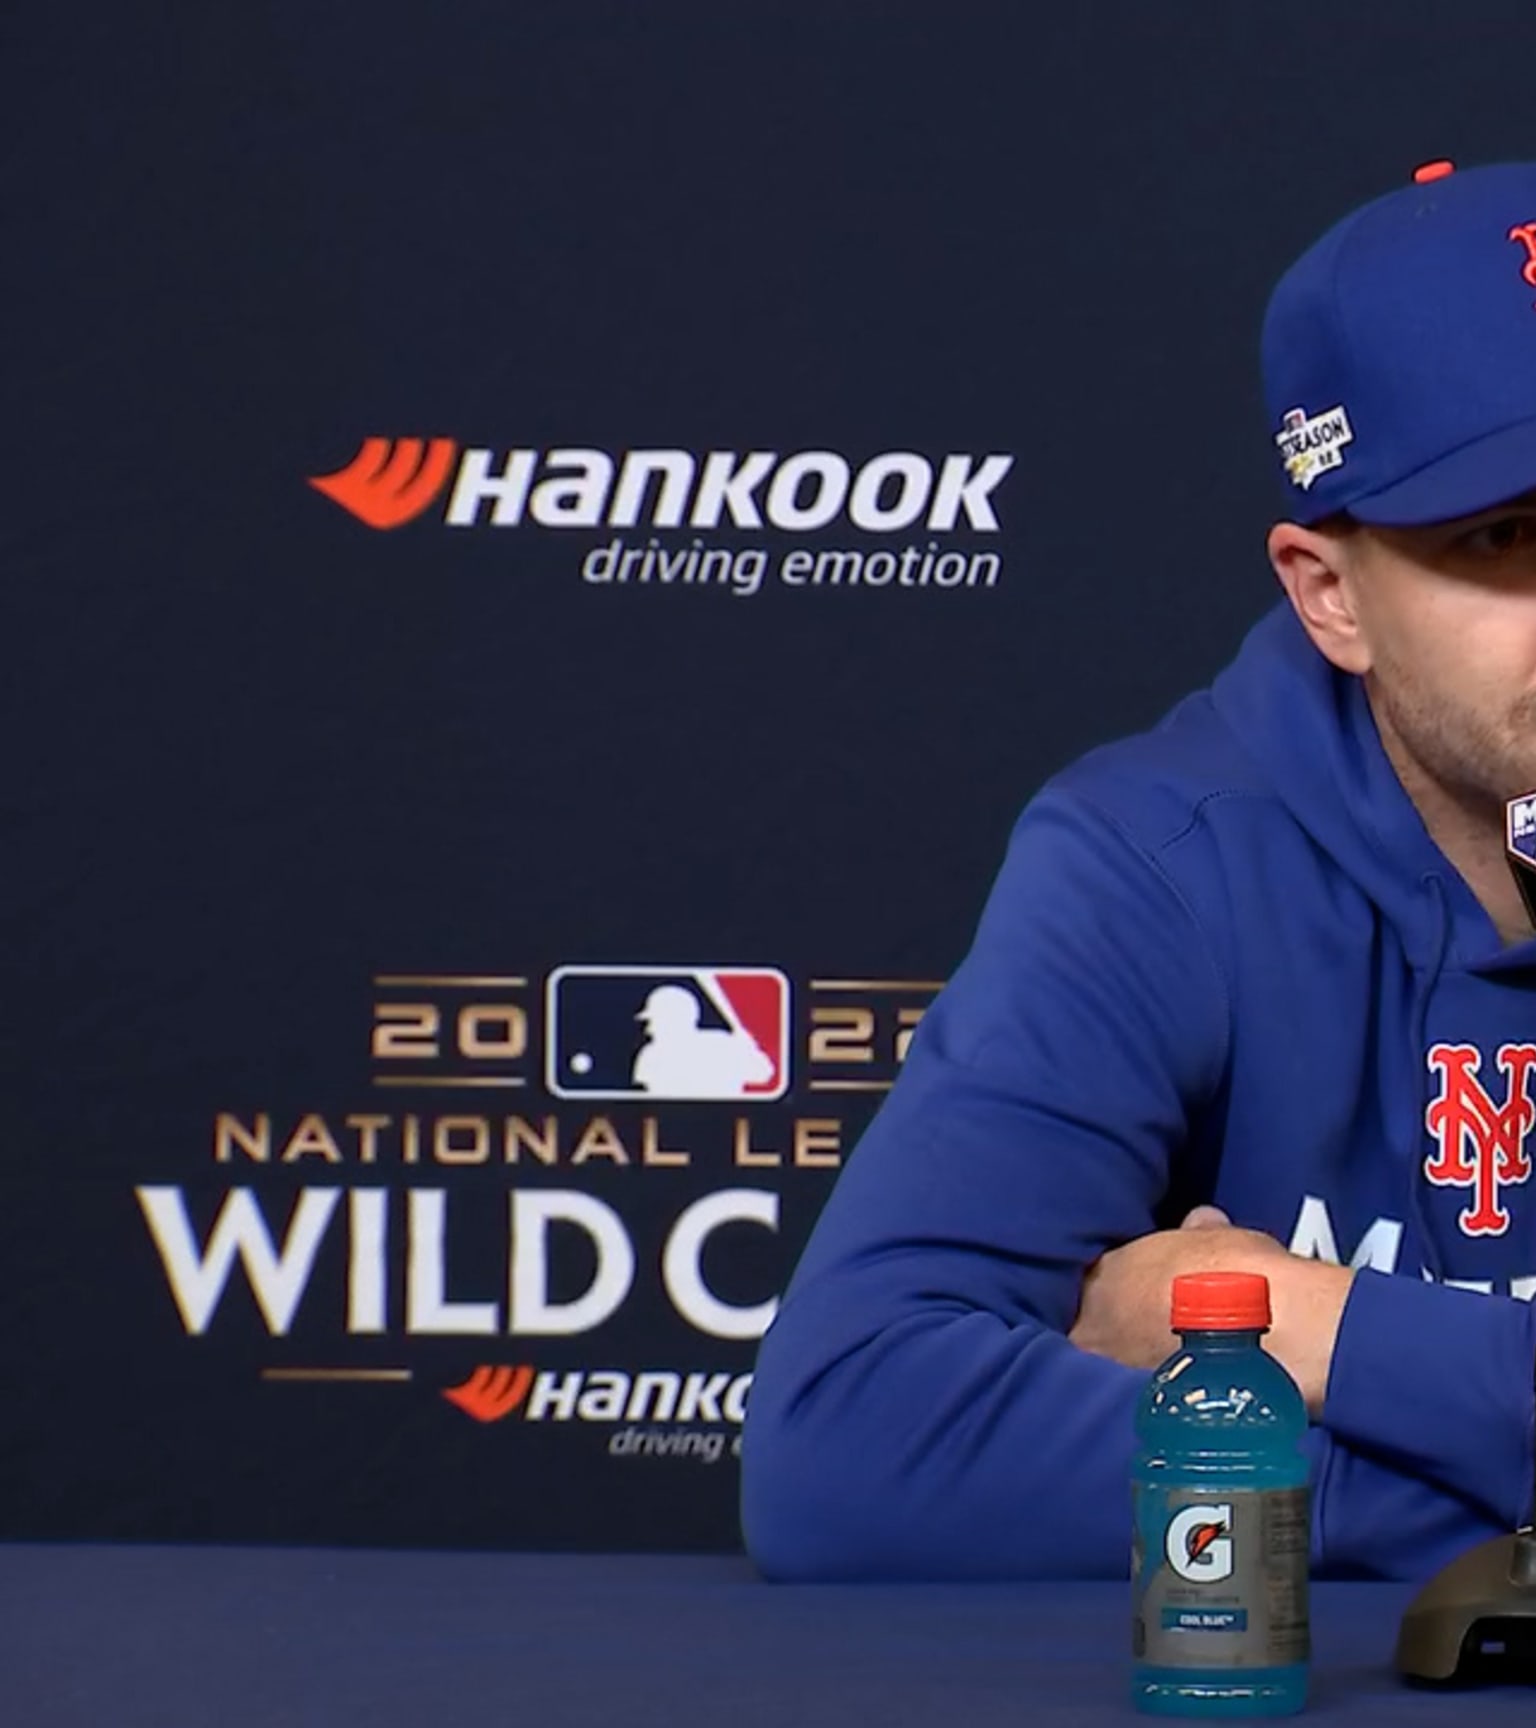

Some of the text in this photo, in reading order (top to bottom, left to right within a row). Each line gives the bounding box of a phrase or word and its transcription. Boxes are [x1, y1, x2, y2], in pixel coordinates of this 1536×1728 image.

[582, 538, 1001, 596] driving emotion
[372, 1004, 528, 1059] 20
[214, 1113, 692, 1166] NATIONAL
[136, 1186, 636, 1336] WILD
[608, 1426, 726, 1463] driving
[1165, 1503, 1234, 1584] G
